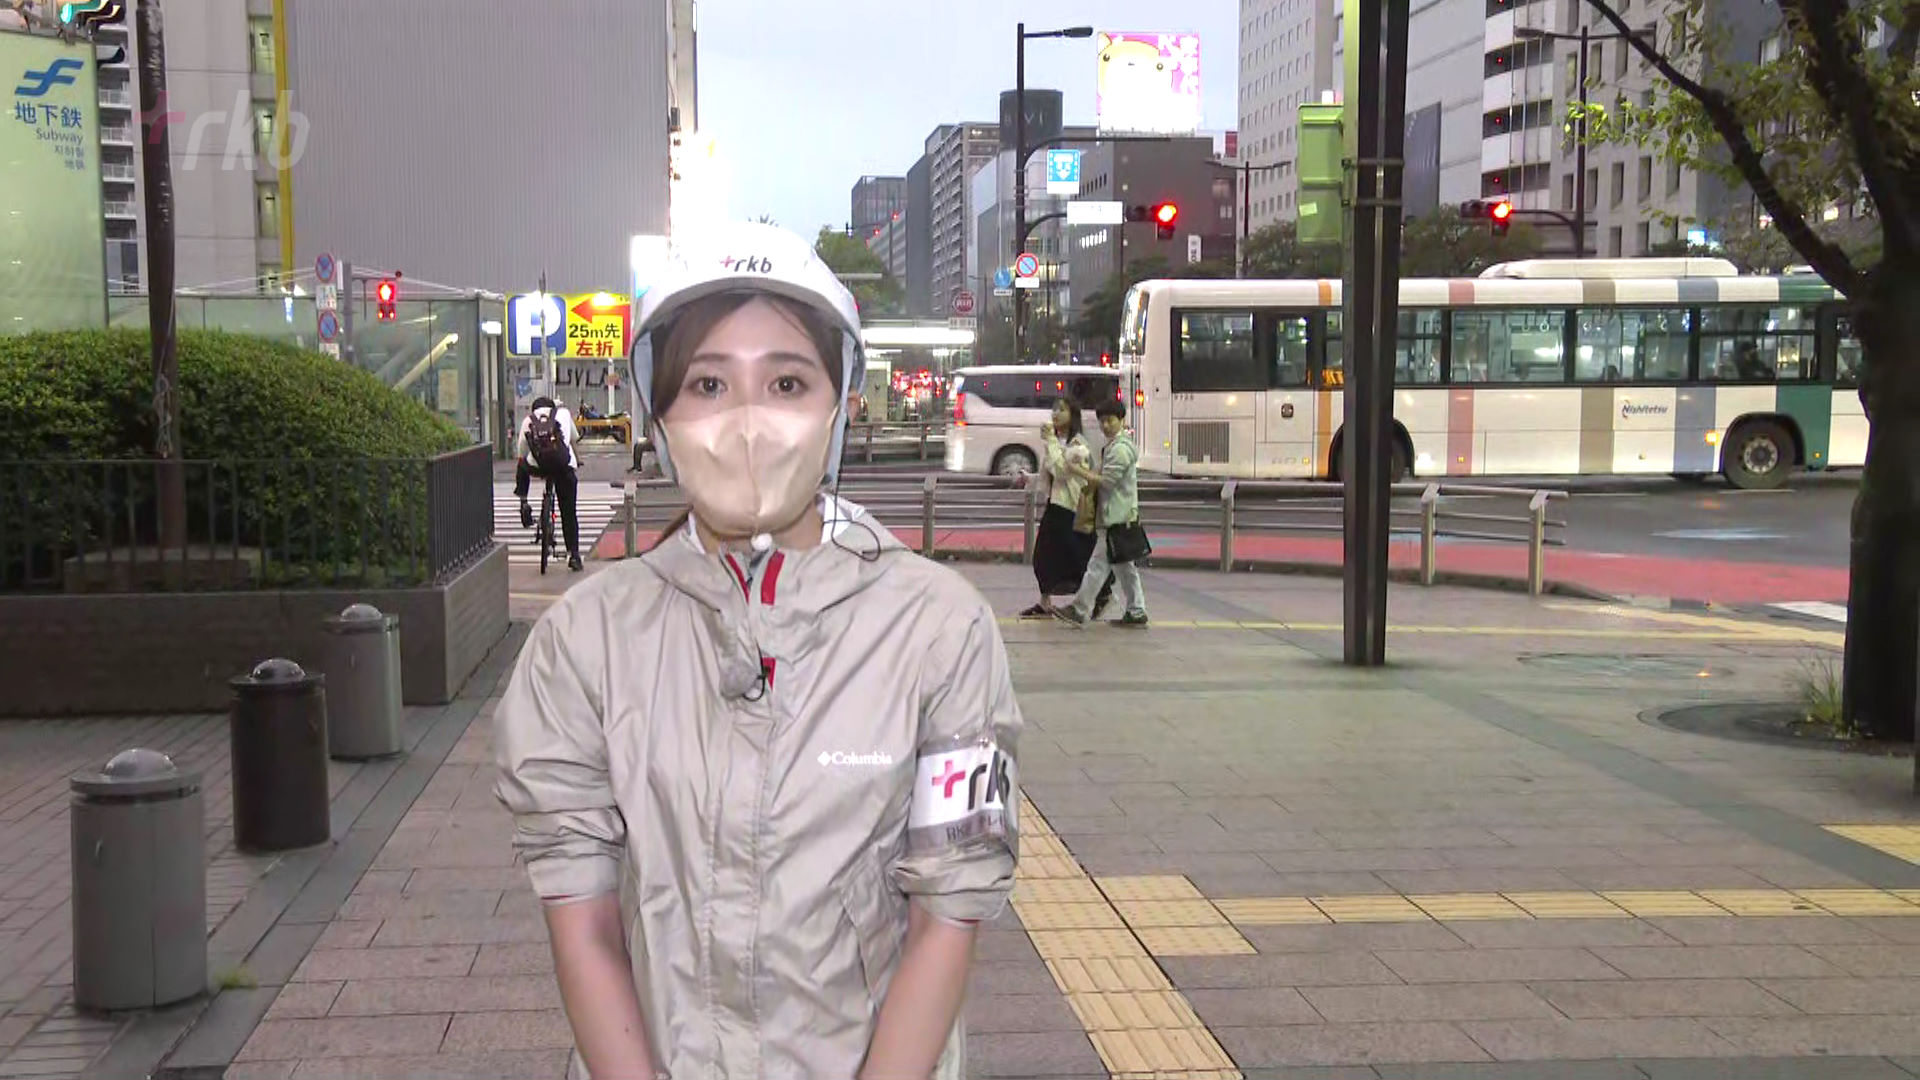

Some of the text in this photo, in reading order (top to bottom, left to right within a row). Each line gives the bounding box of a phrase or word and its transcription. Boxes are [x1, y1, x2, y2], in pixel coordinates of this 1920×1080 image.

[14, 101, 82, 128] 地下鉄
[36, 128, 83, 145] Subway
[515, 292, 562, 354] P
[569, 323, 620, 339] 25m先
[576, 341, 614, 357] 左折
[1622, 404, 1668, 415] Nishitetsu
[831, 751, 892, 765] Columbia
